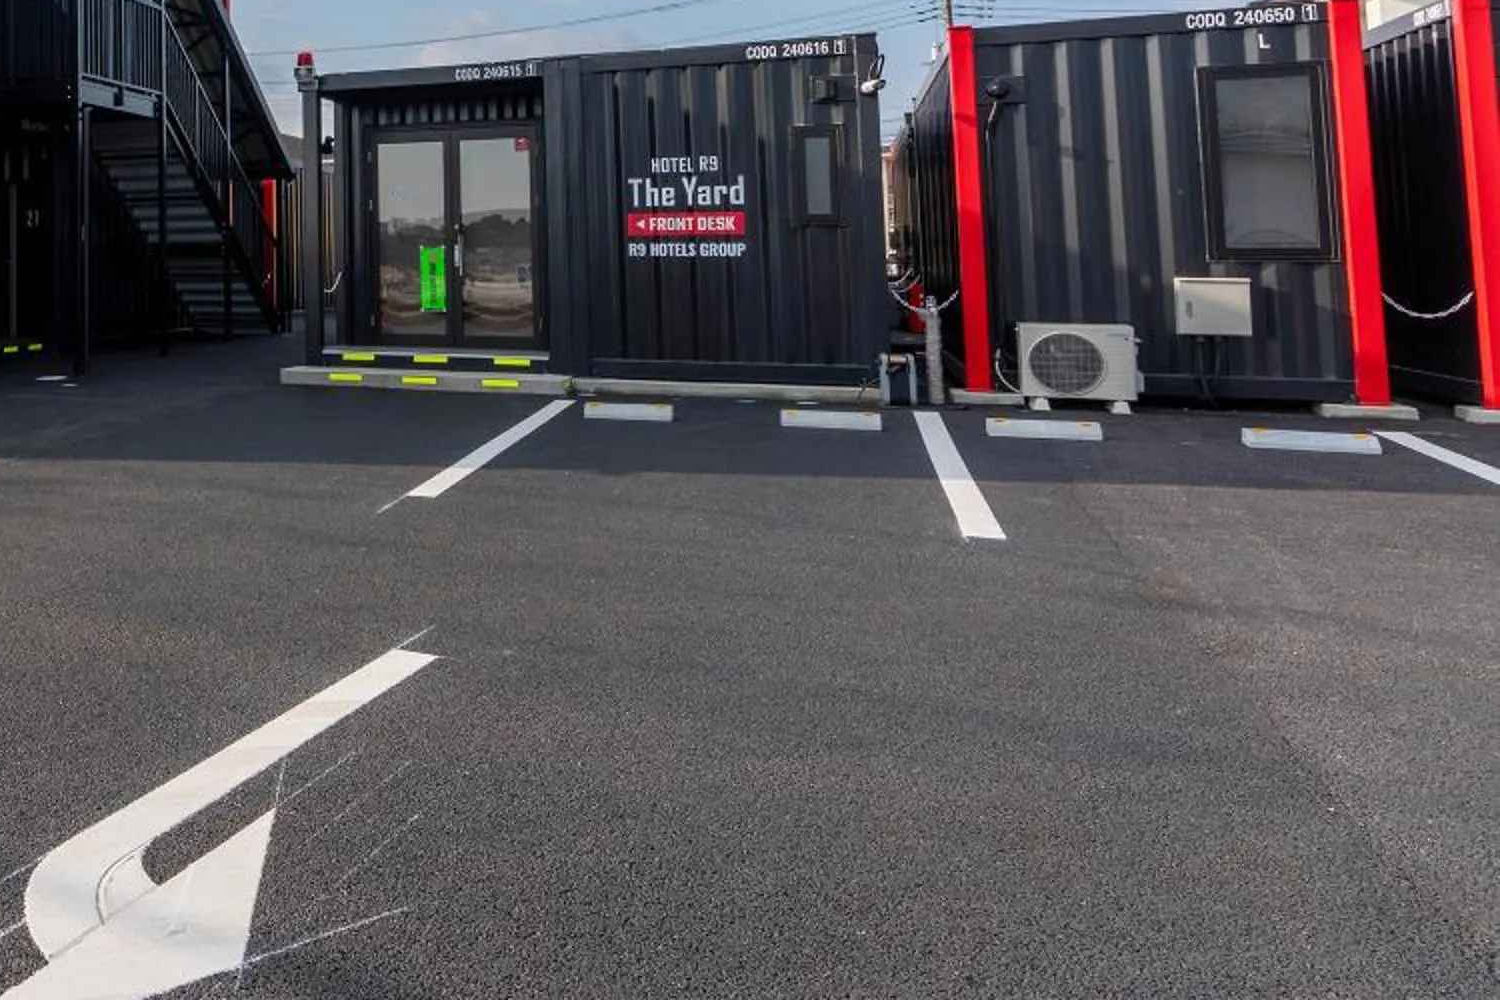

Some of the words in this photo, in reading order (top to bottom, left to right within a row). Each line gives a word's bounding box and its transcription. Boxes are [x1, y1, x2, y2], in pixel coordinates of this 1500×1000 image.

[1234, 7, 1295, 25] 240650
[1257, 33, 1271, 49] L
[651, 156, 694, 174] HOTEL
[699, 155, 719, 172] R9
[627, 176, 676, 207] The
[682, 174, 745, 207] Yard
[649, 216, 694, 231] FRONT
[697, 215, 736, 231] DESK
[628, 244, 647, 257] R9
[650, 243, 698, 257] HOTELS
[699, 242, 747, 257] GROUP
